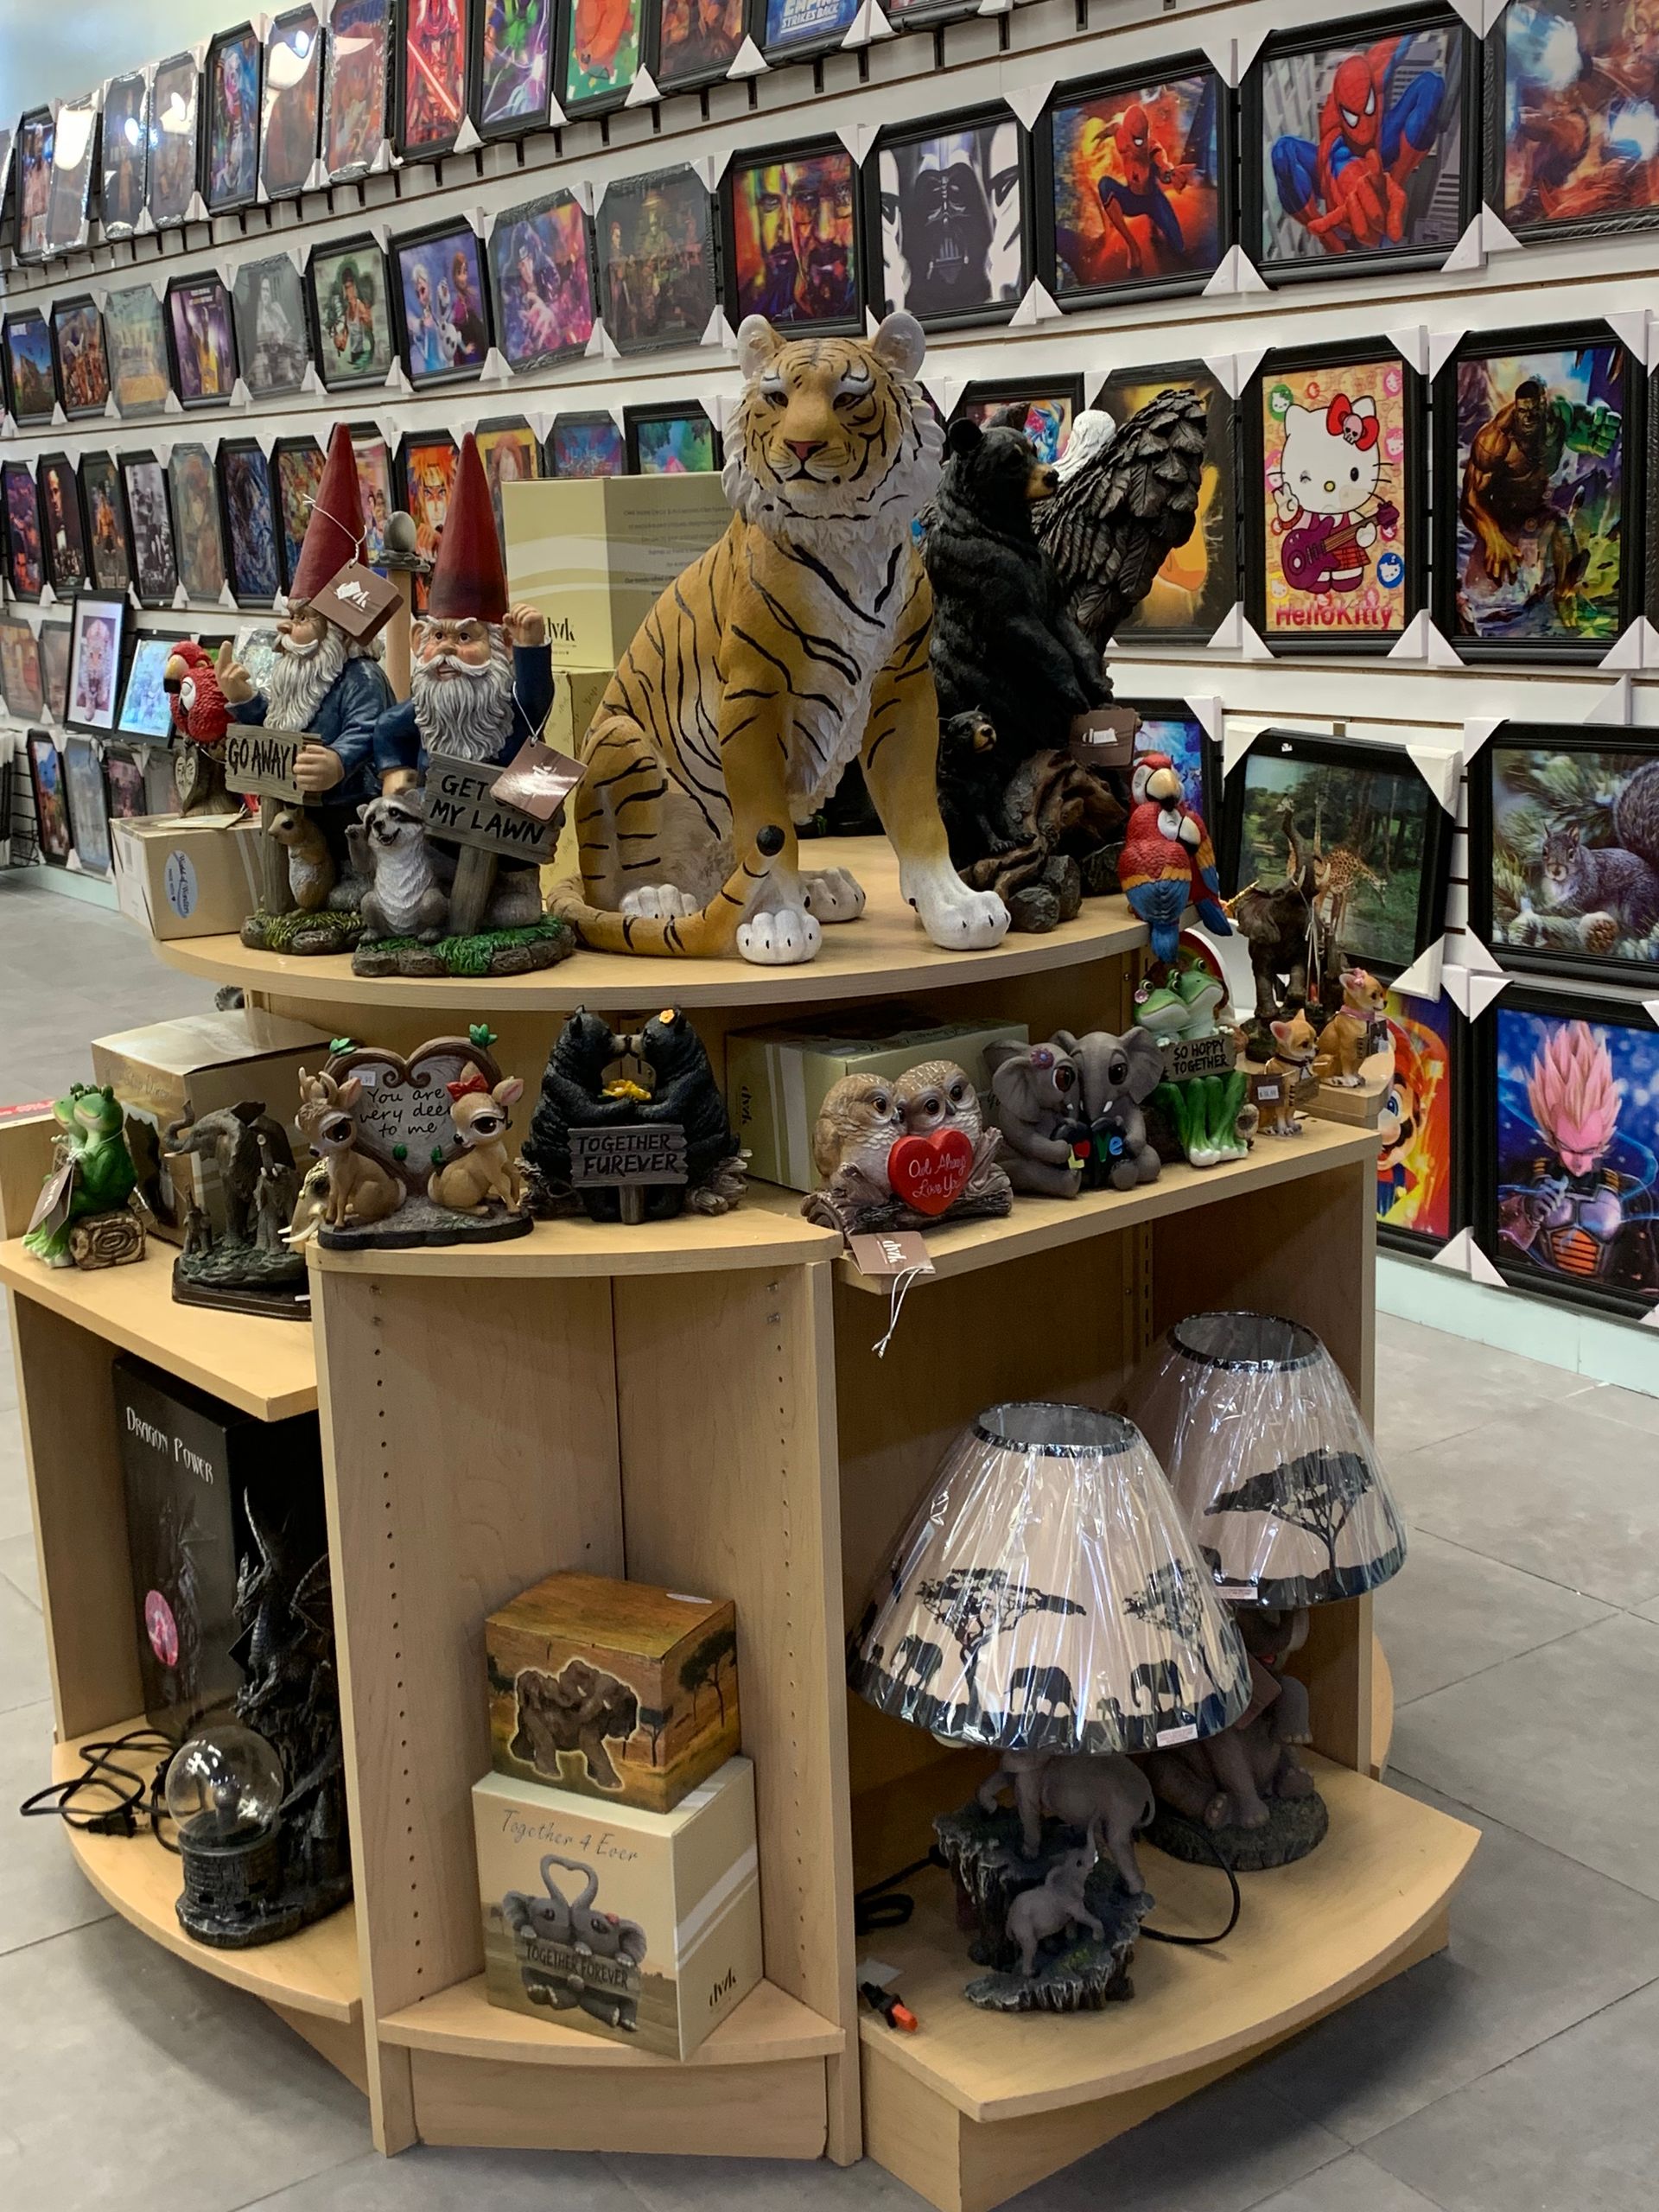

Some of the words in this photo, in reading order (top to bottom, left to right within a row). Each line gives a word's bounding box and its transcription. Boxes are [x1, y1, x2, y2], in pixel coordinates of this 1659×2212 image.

[781, 10, 817, 29] STRIKES
[817, 3, 838, 18] BACK
[228, 738, 249, 775] GO
[251, 738, 297, 791] AWAY!
[442, 774, 489, 801] GET
[429, 798, 466, 827] MY
[470, 810, 546, 844] LAWN
[1174, 1046, 1188, 1061] SO
[1192, 1039, 1224, 1057] HOPPY
[1173, 1054, 1230, 1075] TOGETHER
[367, 1088, 403, 1103] You
[412, 1088, 445, 1101] are
[359, 1109, 404, 1123] very
[378, 1123, 397, 1138] to
[408, 1122, 437, 1135] me
[577, 1134, 673, 1155] TOGETHER
[583, 1153, 680, 1178] FUREVER
[501, 1808, 573, 1847] Together
[580, 1834, 593, 1852] 4
[596, 1832, 639, 1862] Ever
[525, 1937, 579, 1974] TOGETHER
[581, 1955, 629, 1992] FOREVER
